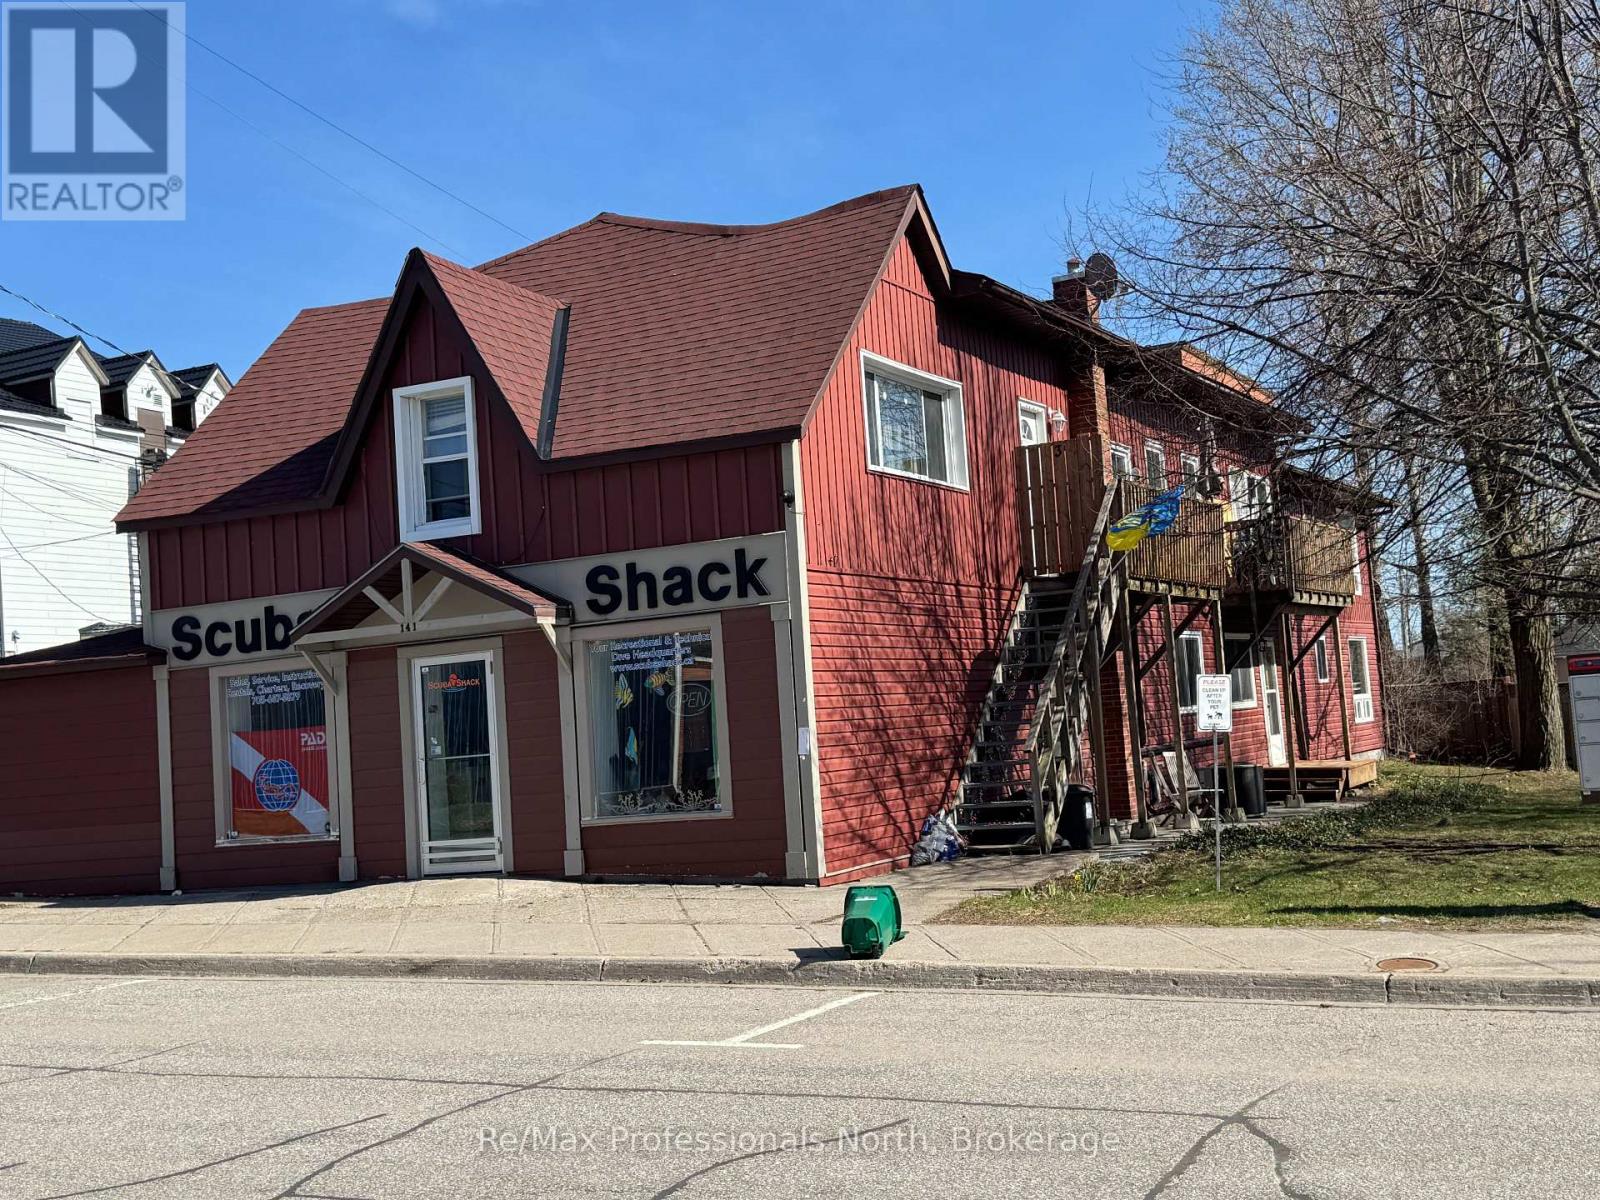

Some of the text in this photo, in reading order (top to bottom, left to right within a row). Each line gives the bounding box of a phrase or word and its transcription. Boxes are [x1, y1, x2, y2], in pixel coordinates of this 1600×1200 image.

[585, 548, 771, 615] Shack
[400, 622, 416, 633] 141
[632, 647, 692, 659] Headquarters
[281, 670, 320, 681] Instructio
[669, 691, 708, 709] OPEN
